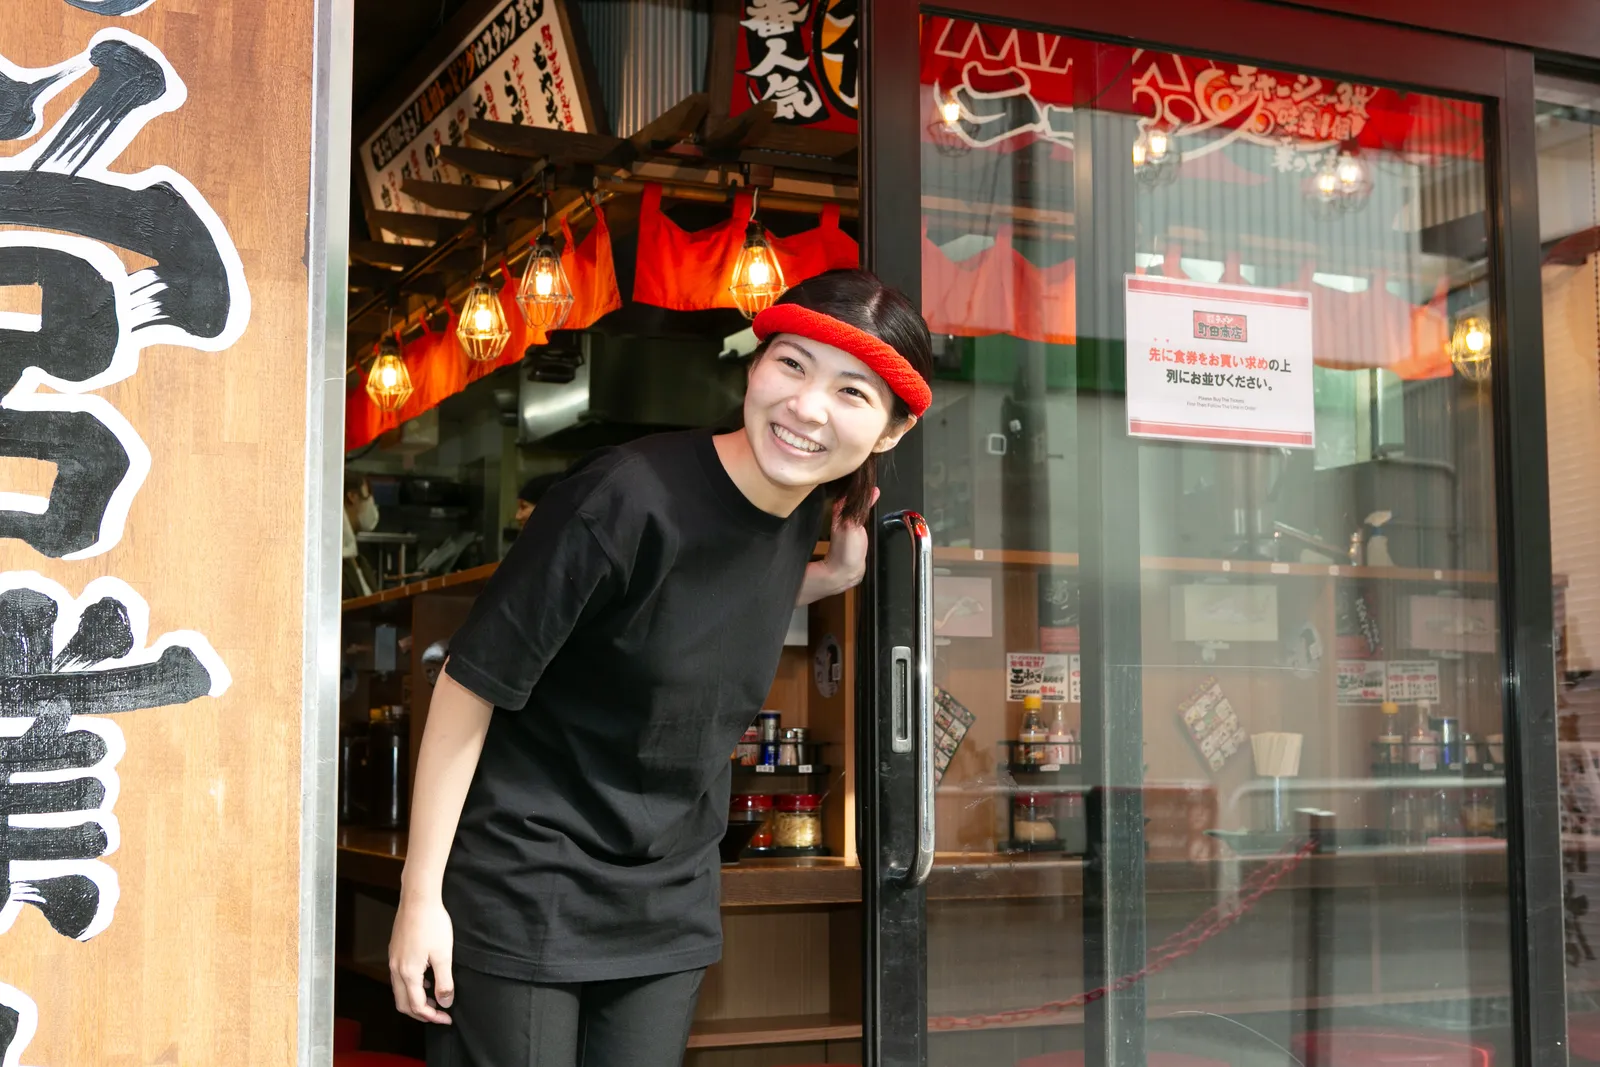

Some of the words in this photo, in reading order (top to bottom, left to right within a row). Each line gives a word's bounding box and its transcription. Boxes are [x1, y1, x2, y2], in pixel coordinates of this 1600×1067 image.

[1149, 347, 1292, 373] 先に食券をお買い求めの上
[1166, 369, 1273, 391] 列にお並びください。
